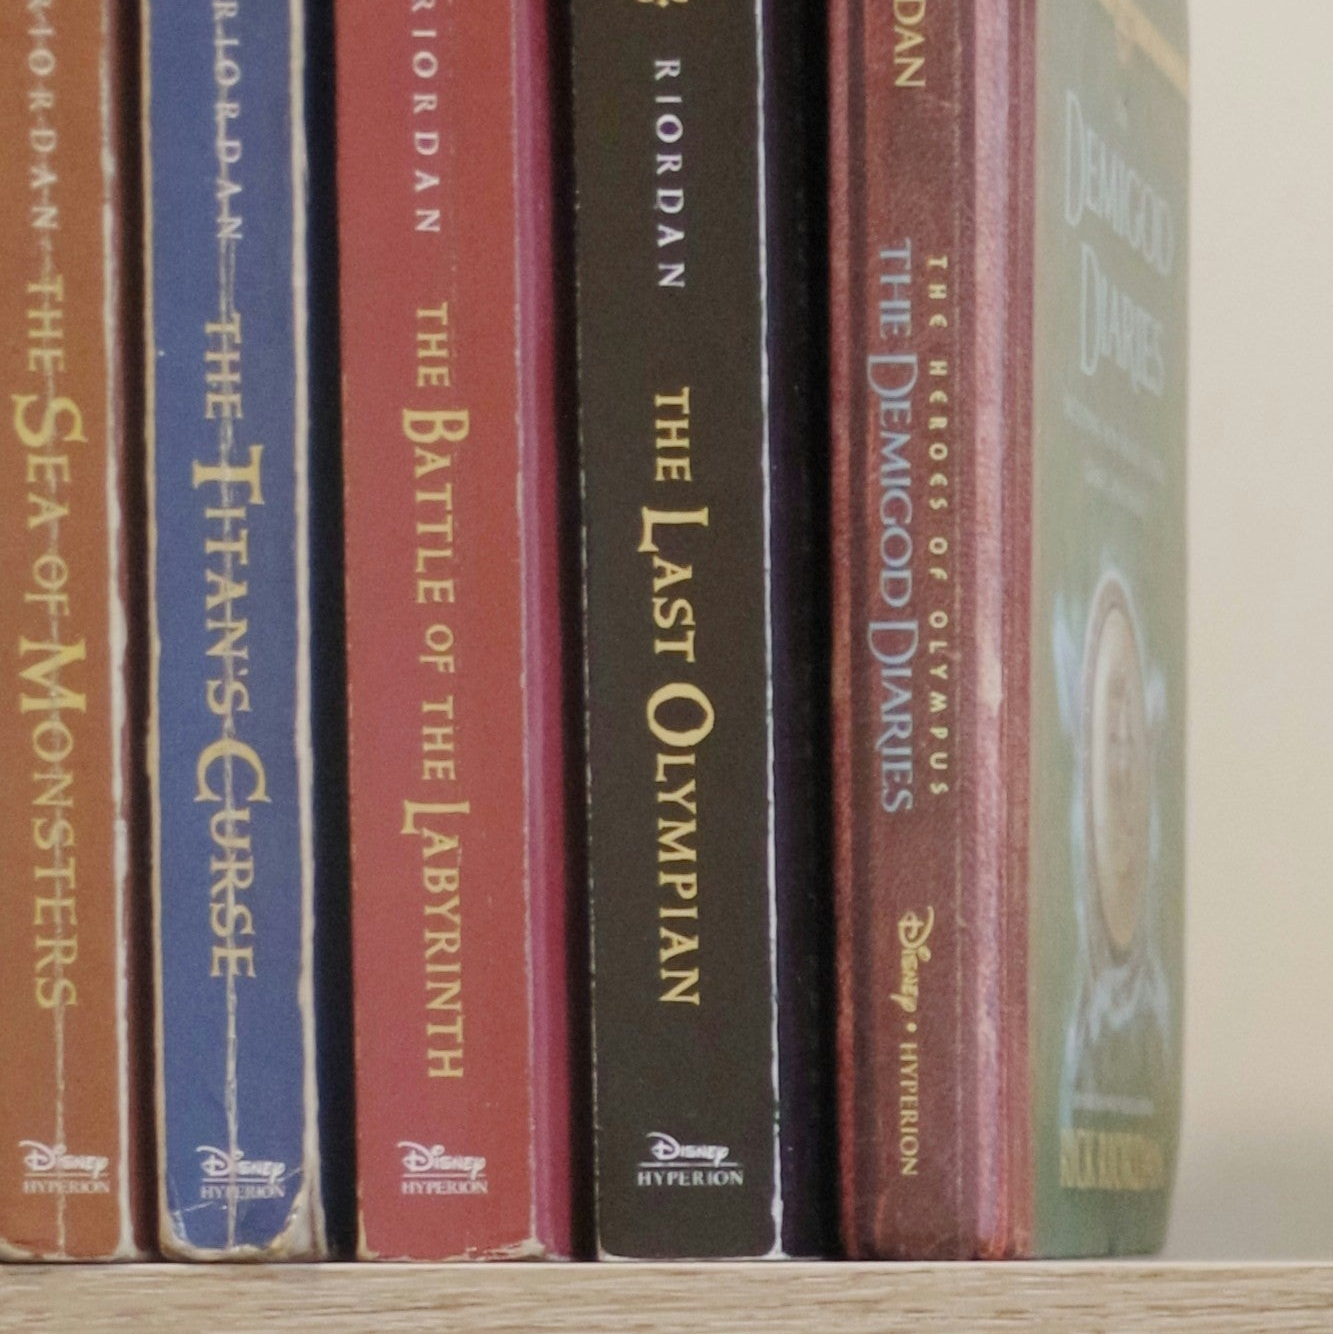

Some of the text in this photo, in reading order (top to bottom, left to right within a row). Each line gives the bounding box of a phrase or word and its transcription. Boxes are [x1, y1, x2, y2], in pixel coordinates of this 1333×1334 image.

[654, 58, 686, 288] RIORDAN
[205, 313, 244, 420] THE
[11, 273, 89, 1010] THE SEA OF MONSTERS
[866, 236, 919, 814] THE DEMIGOD DIARIES
[927, 254, 949, 796] THE HEROES OF OLYMPUS
[400, 302, 471, 1079] THE BATTLE OF THE LABYRINTH
[637, 386, 715, 1007] THE LAST OLYMPIAN
[193, 736, 272, 979] CURSE
[401, 1179, 490, 1196] HYPERION
[636, 1169, 746, 1188] HYPERION
[899, 1042, 920, 1176] HYPERION
